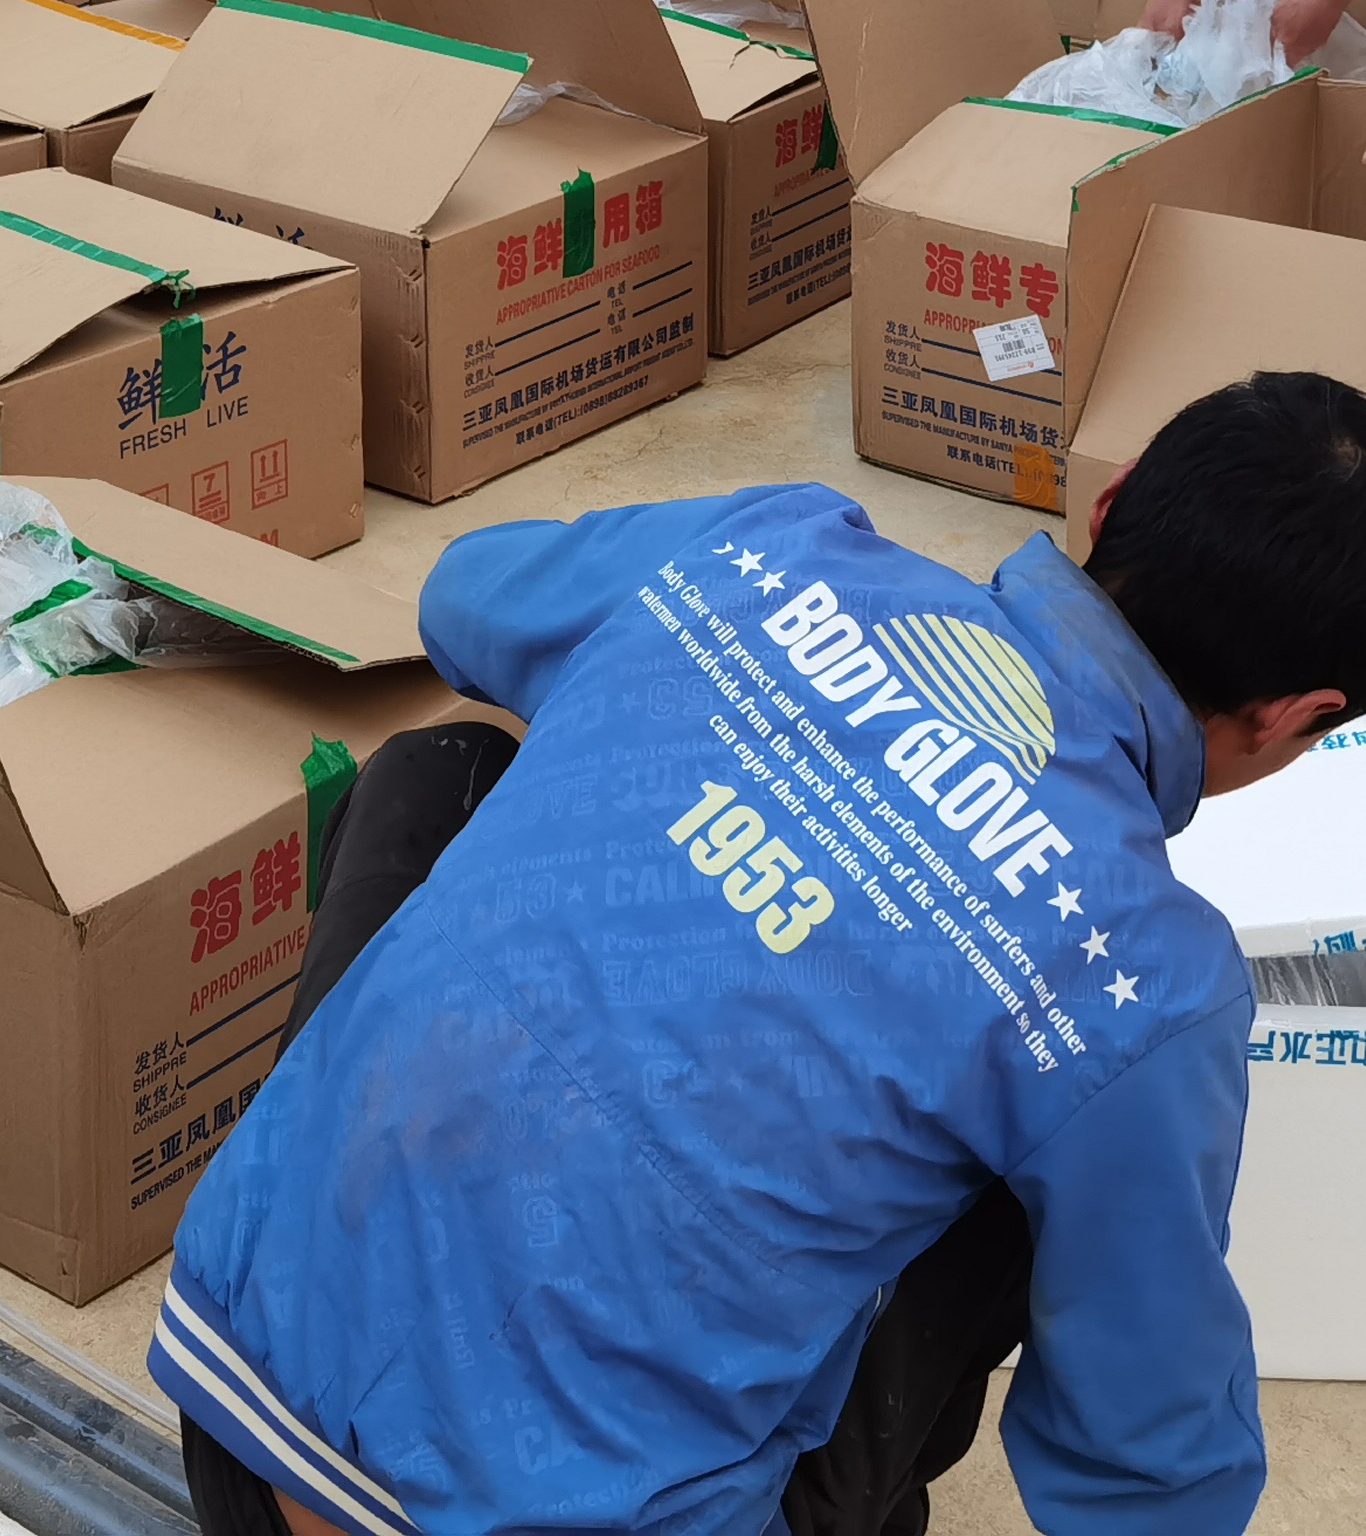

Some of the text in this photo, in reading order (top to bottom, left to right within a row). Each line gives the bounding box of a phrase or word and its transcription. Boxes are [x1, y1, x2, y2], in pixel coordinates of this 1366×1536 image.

[496, 179, 664, 292] 海鲜用箱
[924, 241, 1060, 319] 海鲜专
[885, 320, 921, 342] 发货人
[885, 348, 922, 371] 收货人
[119, 395, 250, 460] FRESH LIVE
[760, 580, 1074, 899] BODY GLOVE
[636, 585, 1060, 1074] watermen worldwide from the harsh elements of the environment so they
[656, 560, 1087, 1056] Body Glove will protect and enhance the performance of surfers and other
[708, 713, 914, 933] can enjoy their activities longer
[189, 830, 303, 965] 海鲜
[665, 779, 836, 955] 1953
[188, 924, 307, 1018] APPROPRIATIVE
[132, 1050, 187, 1094] SHIPPRE
[134, 1030, 185, 1076] 发货人
[132, 1092, 187, 1136] CONSIGNEE
[134, 1074, 185, 1119] 收货人
[130, 1155, 203, 1211] SUPERVISED THE
